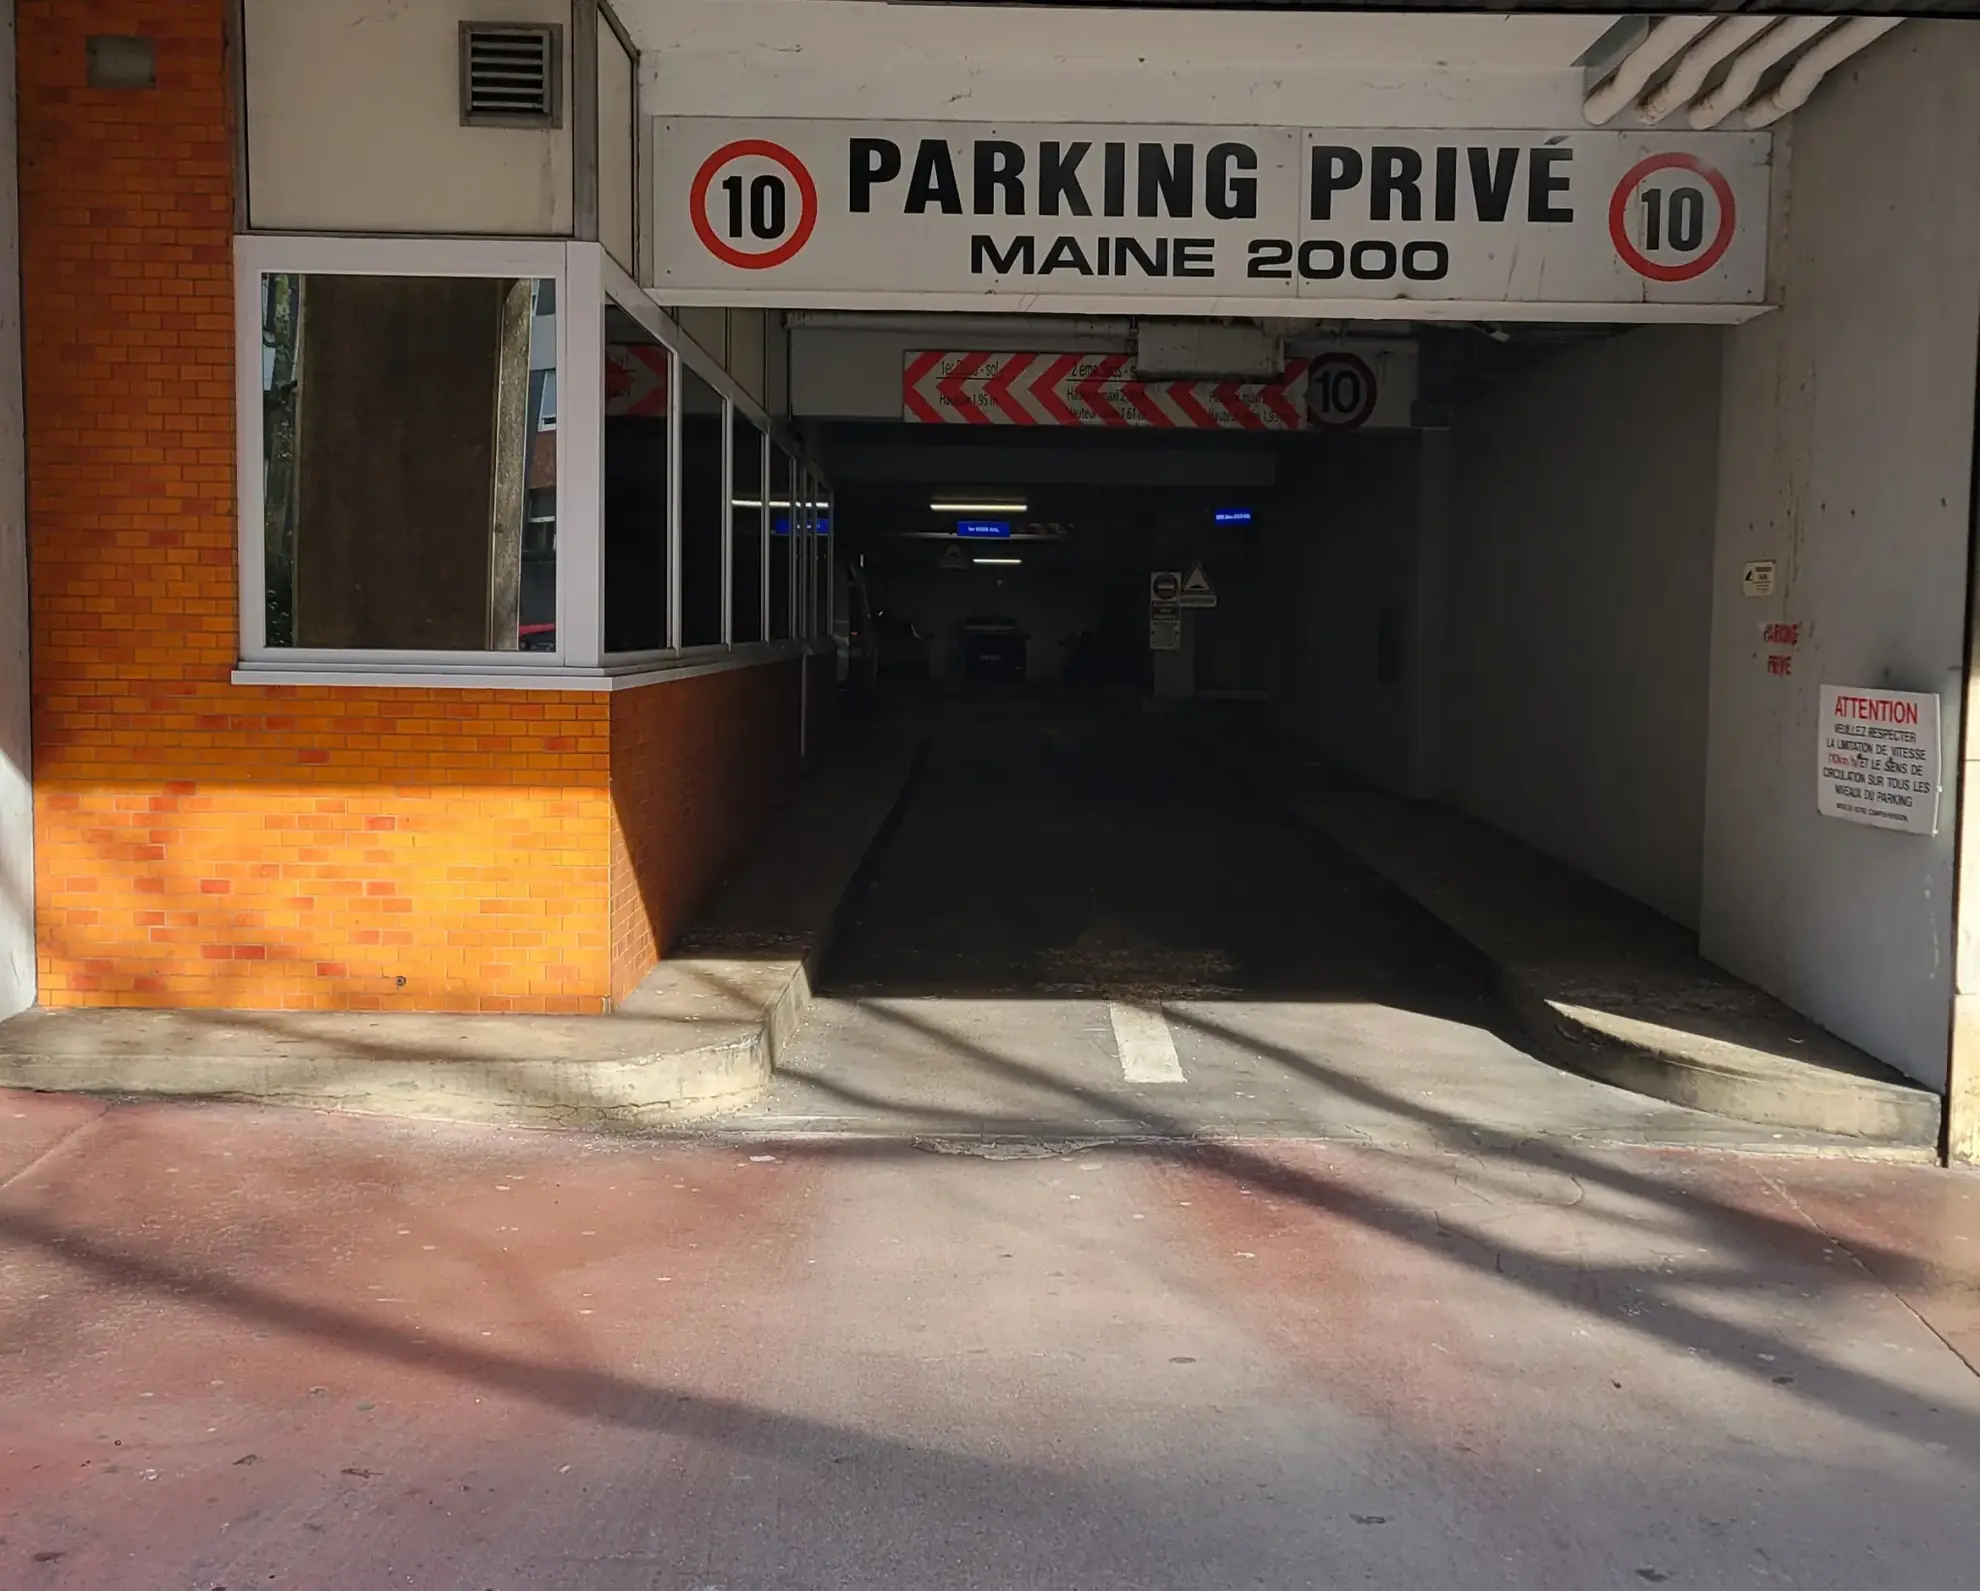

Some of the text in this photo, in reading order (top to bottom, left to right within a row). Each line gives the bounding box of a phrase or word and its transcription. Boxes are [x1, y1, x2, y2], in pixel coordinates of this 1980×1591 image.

[850, 137, 1574, 223] PARKING PRIVÉ
[723, 175, 785, 239] 10
[1642, 187, 1704, 251] 10
[972, 235, 1448, 280] MAINE 2000
[1315, 370, 1360, 413] 10
[1834, 696, 1918, 725] ATTENTION
[1835, 723, 1916, 743] VEUILLEZ RESPECTER
[1826, 738, 1926, 761] LA LIMITATION DE VITESSE
[1823, 767, 1931, 794] CIRCULATION SUR TOUS LES
[1871, 759, 1881, 770] LE
[1884, 760, 1907, 774] SENS
[1911, 764, 1923, 777] DE
[1835, 783, 1913, 807] NIVEAUX DU PARKING
